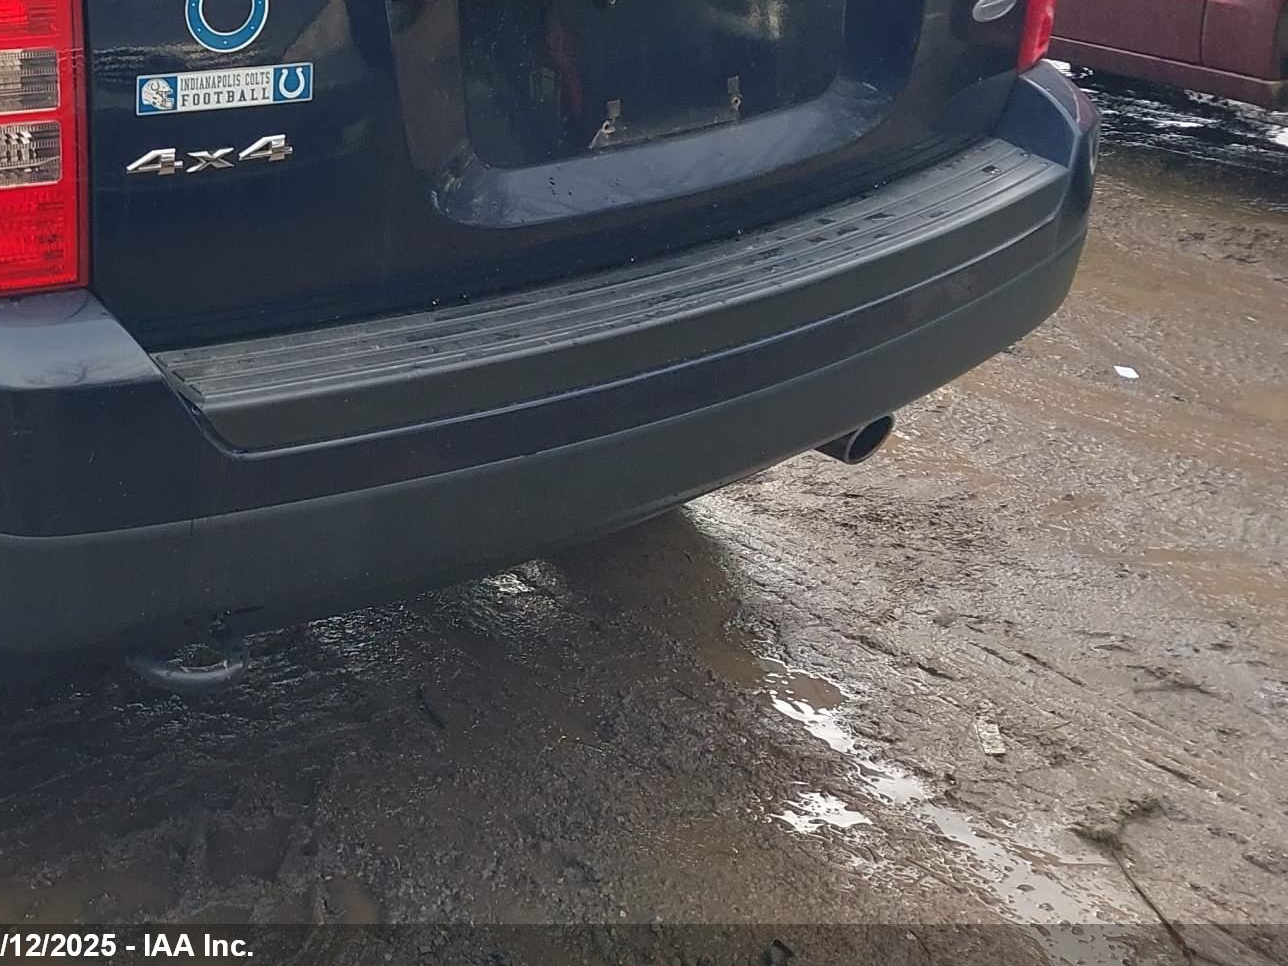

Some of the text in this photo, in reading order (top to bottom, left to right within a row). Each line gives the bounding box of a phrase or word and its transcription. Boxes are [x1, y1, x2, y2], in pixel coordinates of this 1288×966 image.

[180, 70, 270, 91] INDIANAPOLIS COLTS
[182, 87, 270, 107] FOOTBALL
